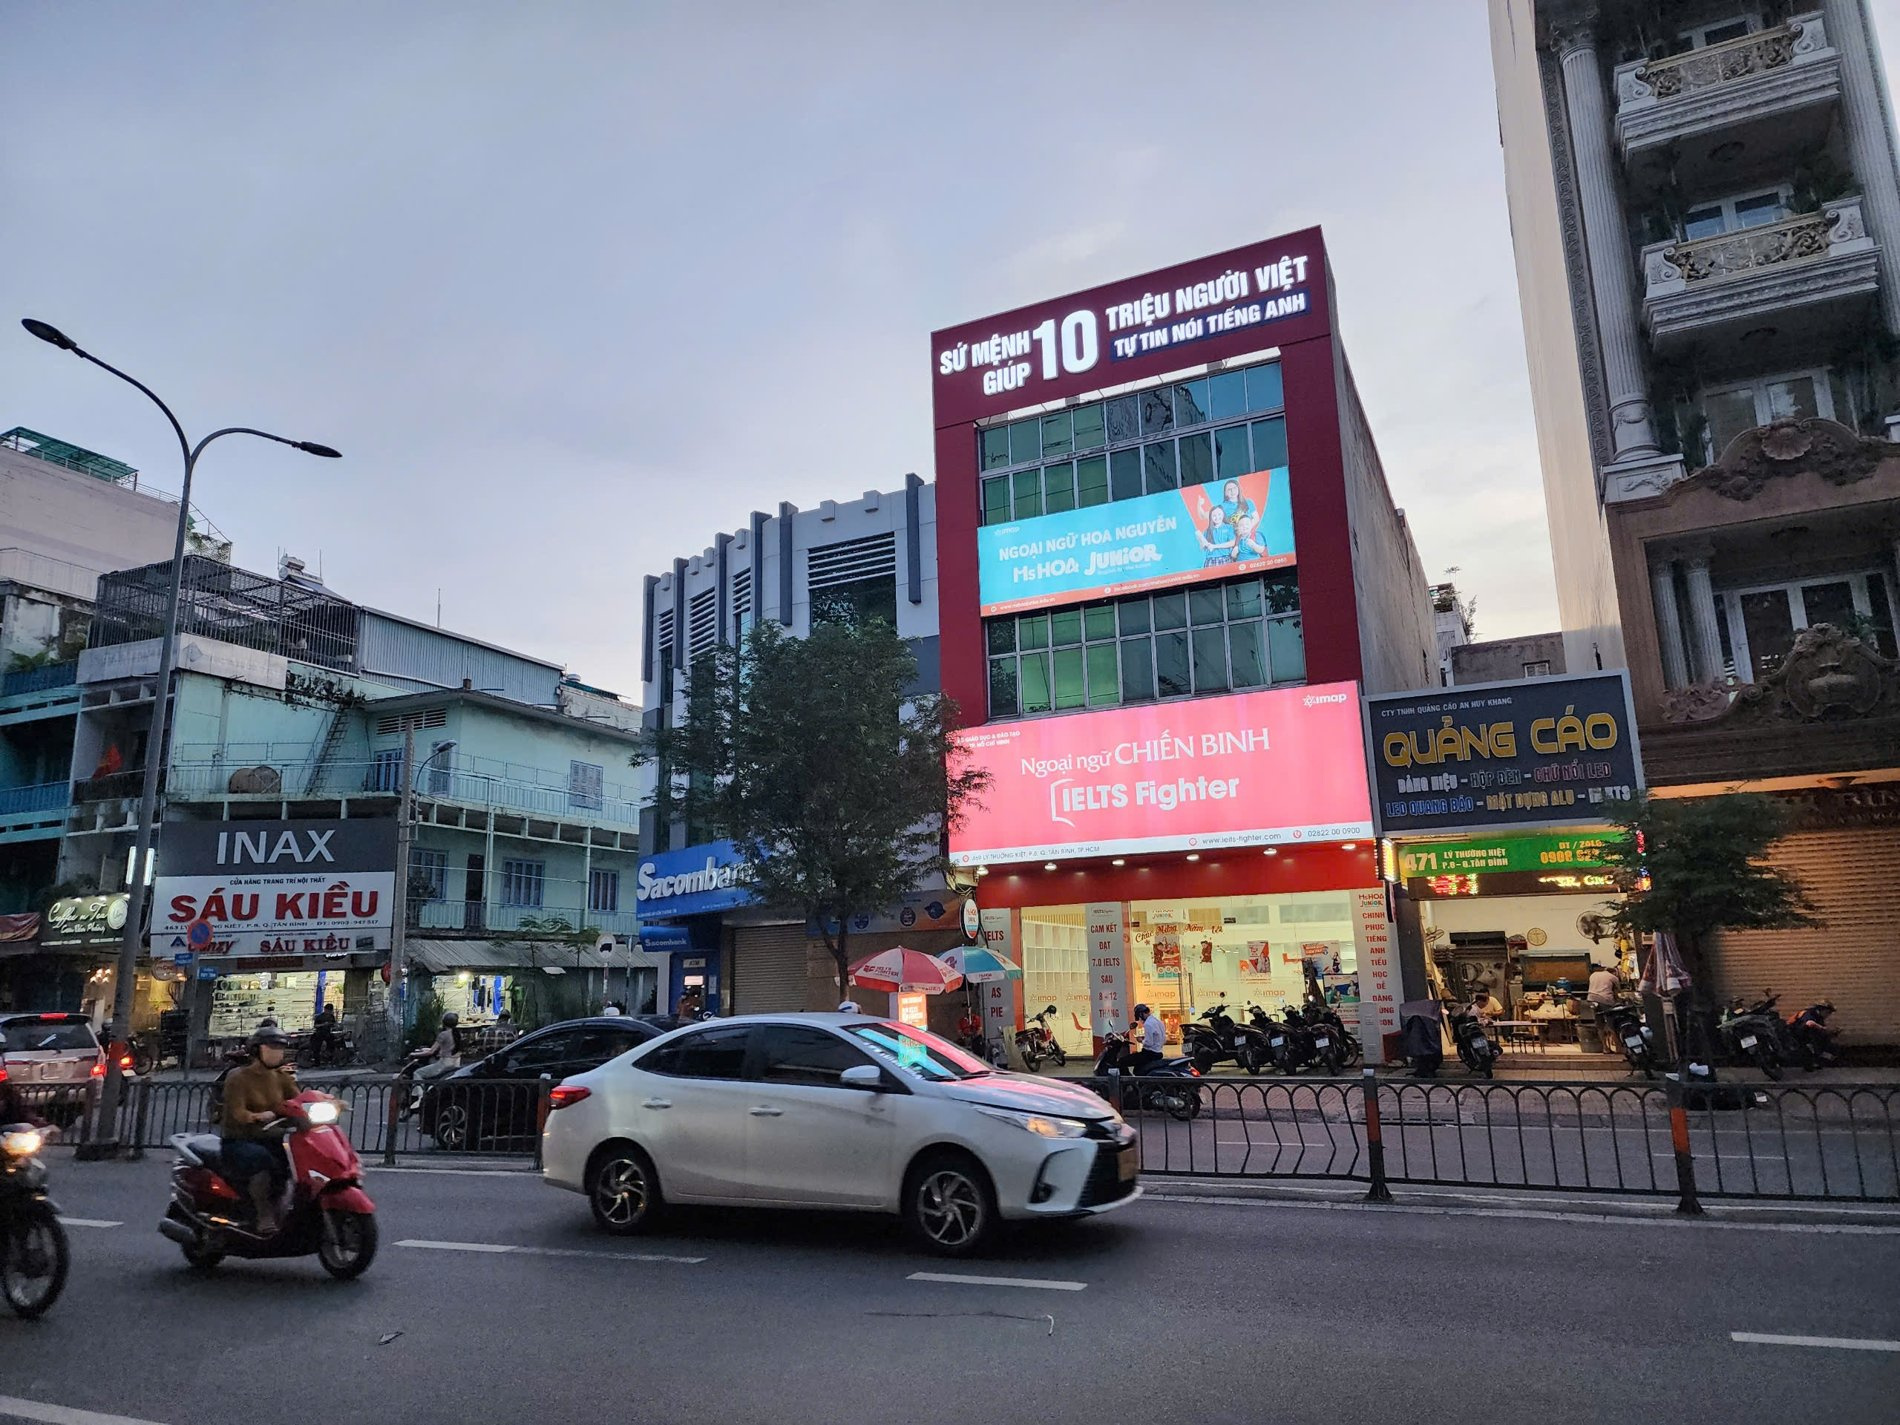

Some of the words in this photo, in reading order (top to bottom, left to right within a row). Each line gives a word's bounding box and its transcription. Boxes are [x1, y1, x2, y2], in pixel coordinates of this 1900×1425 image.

[1106, 292, 1170, 332] TRIỆU
[1176, 269, 1248, 314] NGƯỜI
[1254, 255, 1308, 292] VIỆT
[1115, 336, 1138, 359] TỰ
[1139, 329, 1169, 352] TIN
[1172, 317, 1204, 344] NÓI
[1206, 302, 1262, 334] TIẾNG
[1264, 292, 1306, 320] ANH
[940, 341, 968, 375] SỨ
[971, 330, 1031, 367] MỆNH
[1033, 310, 1099, 381] 10
[983, 361, 1031, 396] GIÚP
[999, 540, 1043, 561] NGOẠI
[1045, 532, 1079, 553] NGỮ
[1080, 530, 1112, 547] HOA
[1381, 709, 1395, 717] CTY
[1397, 707, 1415, 715] TNHH
[1417, 703, 1441, 714] QUẢNG
[1443, 701, 1457, 711] CÁO
[1460, 701, 1470, 709] AN
[1471, 700, 1485, 708] HUY
[1487, 696, 1513, 706] KHANG
[1383, 715, 1517, 768] QUẢNG
[1530, 704, 1619, 756] CÁO
[1021, 756, 1073, 778] Ngoại
[1076, 750, 1112, 771] ngữ
[1115, 729, 1194, 765] CHIẾN
[1202, 727, 1271, 756] BINH
[1430, 772, 1458, 792] HIỆU
[1469, 769, 1494, 789] HỘP
[1496, 767, 1521, 786] ĐÈN
[1534, 762, 1560, 783] CHỮ
[1562, 758, 1585, 781] NỔI
[1587, 761, 1612, 779] LED
[1062, 782, 1128, 812] IELTS
[1136, 775, 1240, 810] Fighter
[1386, 800, 1407, 818] LED
[1409, 798, 1448, 816] QUANG
[1450, 794, 1474, 813] BÁO
[1486, 791, 1513, 812] MẶT
[1515, 791, 1549, 811] DỰNG
[1551, 789, 1575, 806] ALU
[1307, 829, 1329, 838] 02822
[1331, 828, 1341, 836] 00
[1342, 826, 1361, 835] 0900
[216, 829, 336, 865] INAX
[1540, 850, 1573, 864] 0908
[1405, 852, 1438, 871] 471
[1444, 850, 1453, 859] LÝ
[1455, 848, 1487, 858] THƯỜNG
[1488, 847, 1506, 858] KIỆT
[1488, 857, 1508, 867] BÌNH
[230, 877, 243, 886] CỬA
[285, 877, 297, 885] TRÍ
[297, 877, 309, 885] NỘI
[309, 876, 326, 884] THẤT
[168, 887, 260, 923] SÁU
[274, 880, 379, 920] KIỀU
[1090, 925, 1105, 934] CAM
[1106, 922, 1118, 933] KẾT
[260, 937, 296, 953] SÁU
[303, 932, 350, 952] KIỀU
[645, 938, 687, 947] Sacombank
[1099, 941, 1111, 952] ĐẠT
[1092, 958, 1102, 967] 7.0
[1103, 957, 1121, 966] IELTS
[1100, 975, 1114, 984] SAU
[991, 987, 1002, 999] AS
[1098, 992, 1103, 1000] 8
[1109, 991, 1117, 1000] 12
[1262, 989, 1286, 998] imap
[991, 1007, 1003, 1018] PIE
